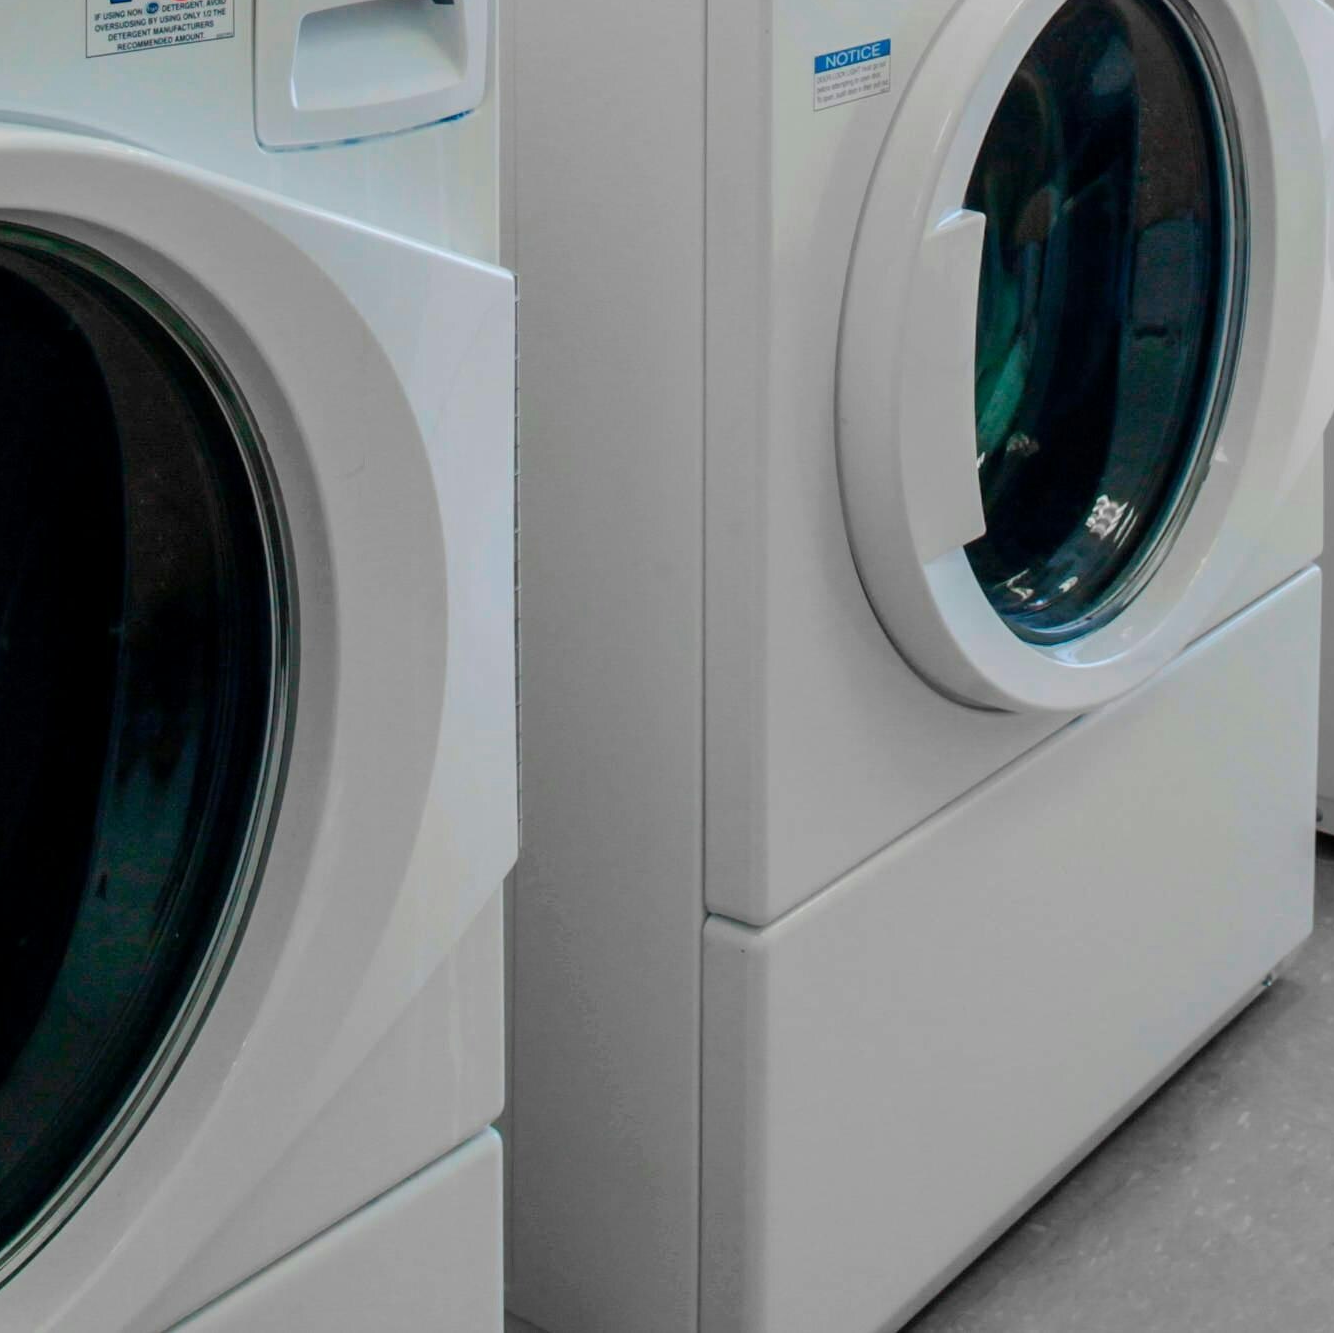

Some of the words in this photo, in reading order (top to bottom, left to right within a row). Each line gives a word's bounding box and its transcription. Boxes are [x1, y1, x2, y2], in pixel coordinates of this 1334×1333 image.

[94, 17, 146, 33] OVERSUDSING
[148, 16, 157, 26] BY
[159, 13, 181, 24] USING
[182, 10, 200, 21] ONLY
[213, 6, 226, 16] THE
[103, 10, 126, 21] USING
[127, 8, 143, 18] NON
[107, 28, 151, 42] DETERGENT
[117, 36, 173, 51] RECOMMENDED
[825, 43, 882, 69] NOTICE
